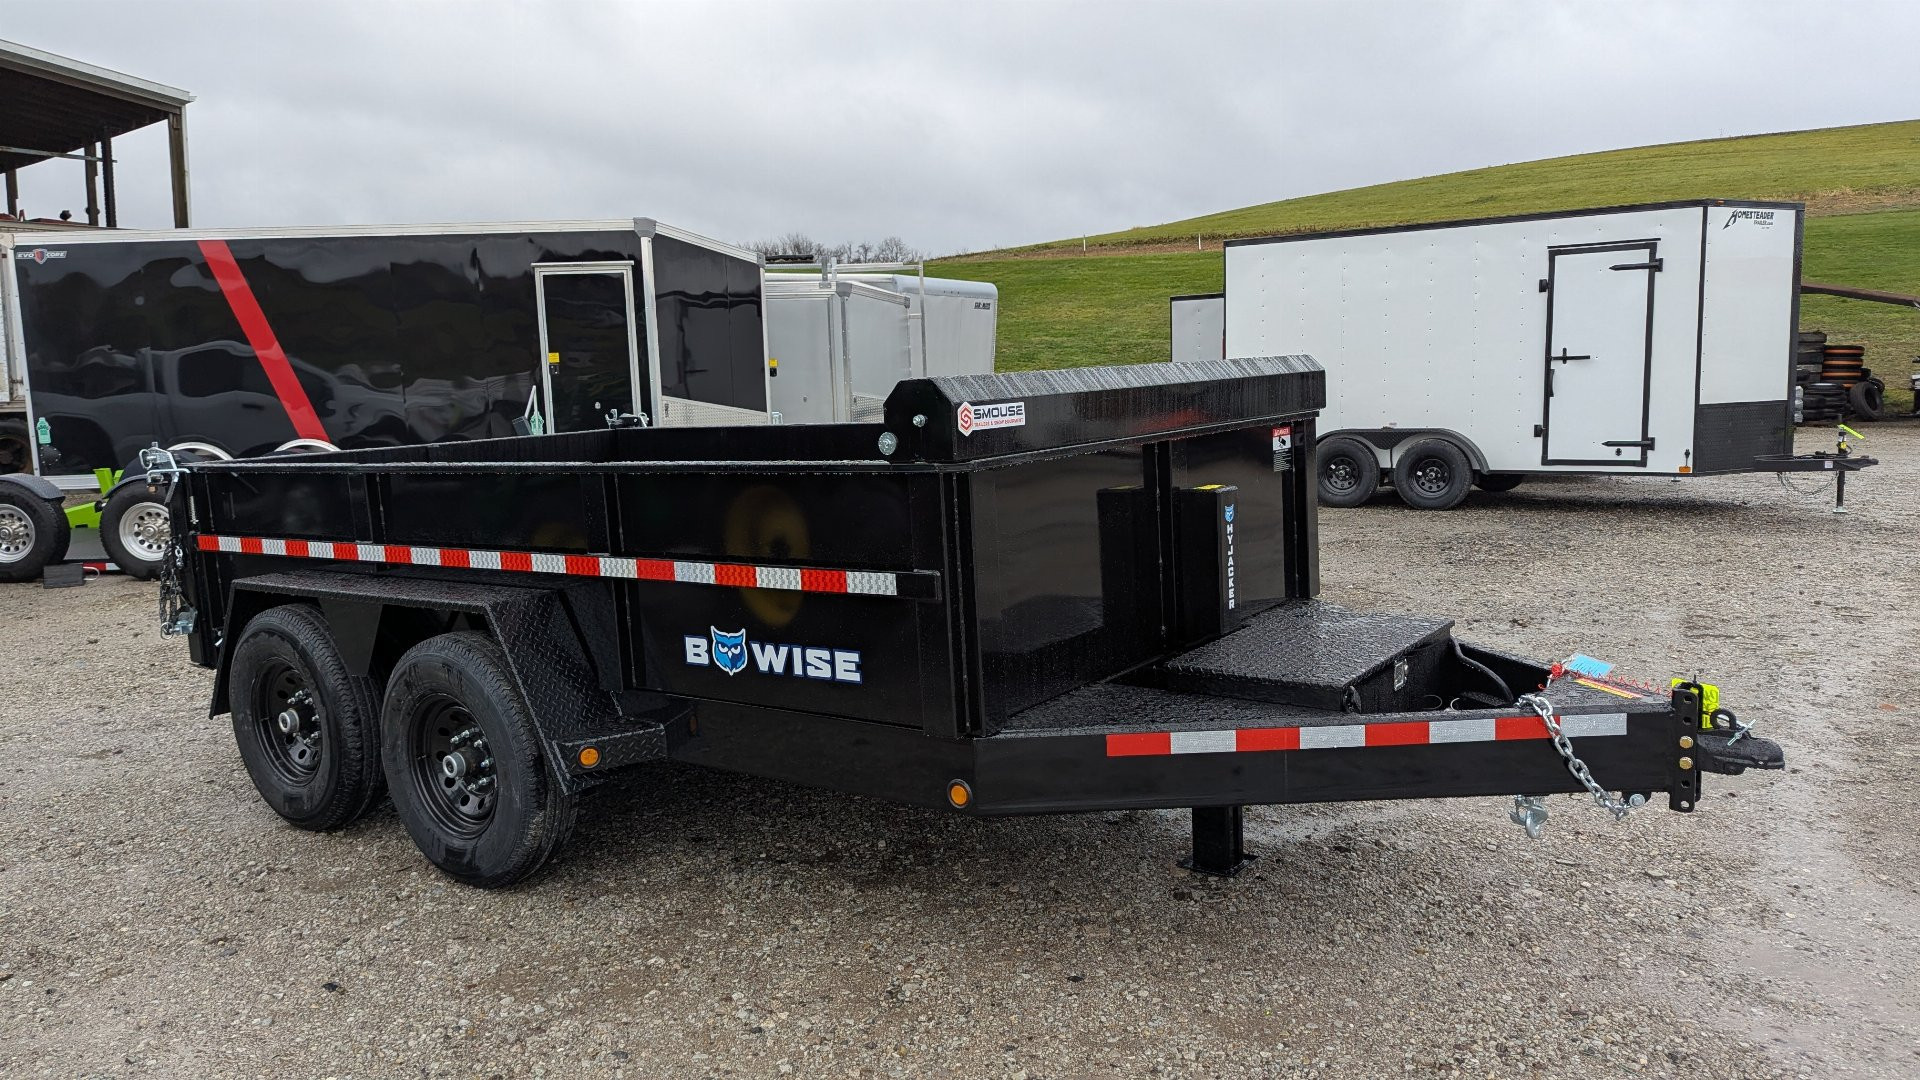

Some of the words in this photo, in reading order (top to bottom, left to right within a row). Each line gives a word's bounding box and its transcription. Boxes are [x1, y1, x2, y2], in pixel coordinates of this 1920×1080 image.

[1723, 209, 1774, 229] HOMESTEADER
[974, 405, 1024, 420] SMOUSE
[1226, 523, 1235, 610] HYJACKER
